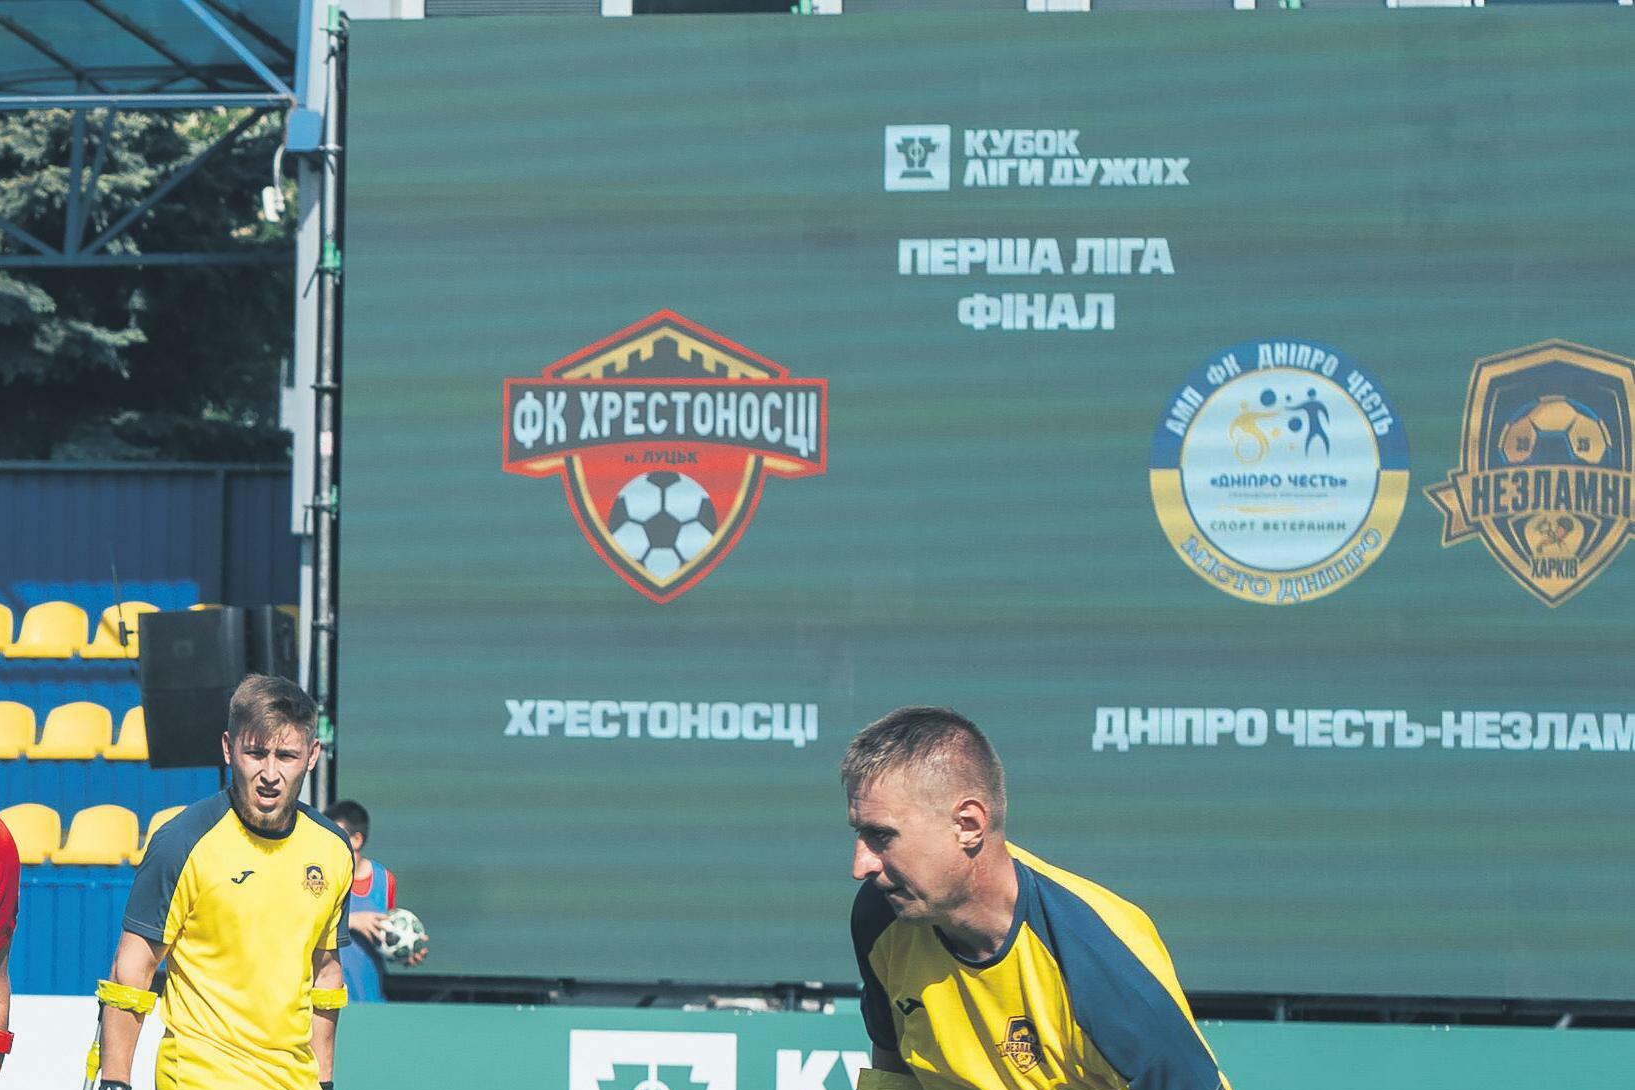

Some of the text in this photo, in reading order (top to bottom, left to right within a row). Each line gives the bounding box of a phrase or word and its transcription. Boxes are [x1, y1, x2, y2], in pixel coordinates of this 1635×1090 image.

[964, 129, 1080, 157] КУБОК
[963, 158, 1190, 187] ЛІГИ ДУЖИХ
[898, 237, 1175, 275] ПЕРША ЛІГА
[957, 292, 1116, 331] ФІНАЛ
[1166, 342, 1394, 438] АМП ФК ДНІПРО ЧЕСТЬ
[513, 390, 818, 457] ФК ХРЕСТОНОСЦІ
[1471, 469, 1631, 518] НЕЗЛАМНІ
[1210, 519, 1255, 531] СПОРТ
[1531, 557, 1578, 579] ХАРКІВ
[503, 700, 818, 747] ХРЕСТОНОСЦІ
[1092, 707, 1268, 752] ДНІПРО
